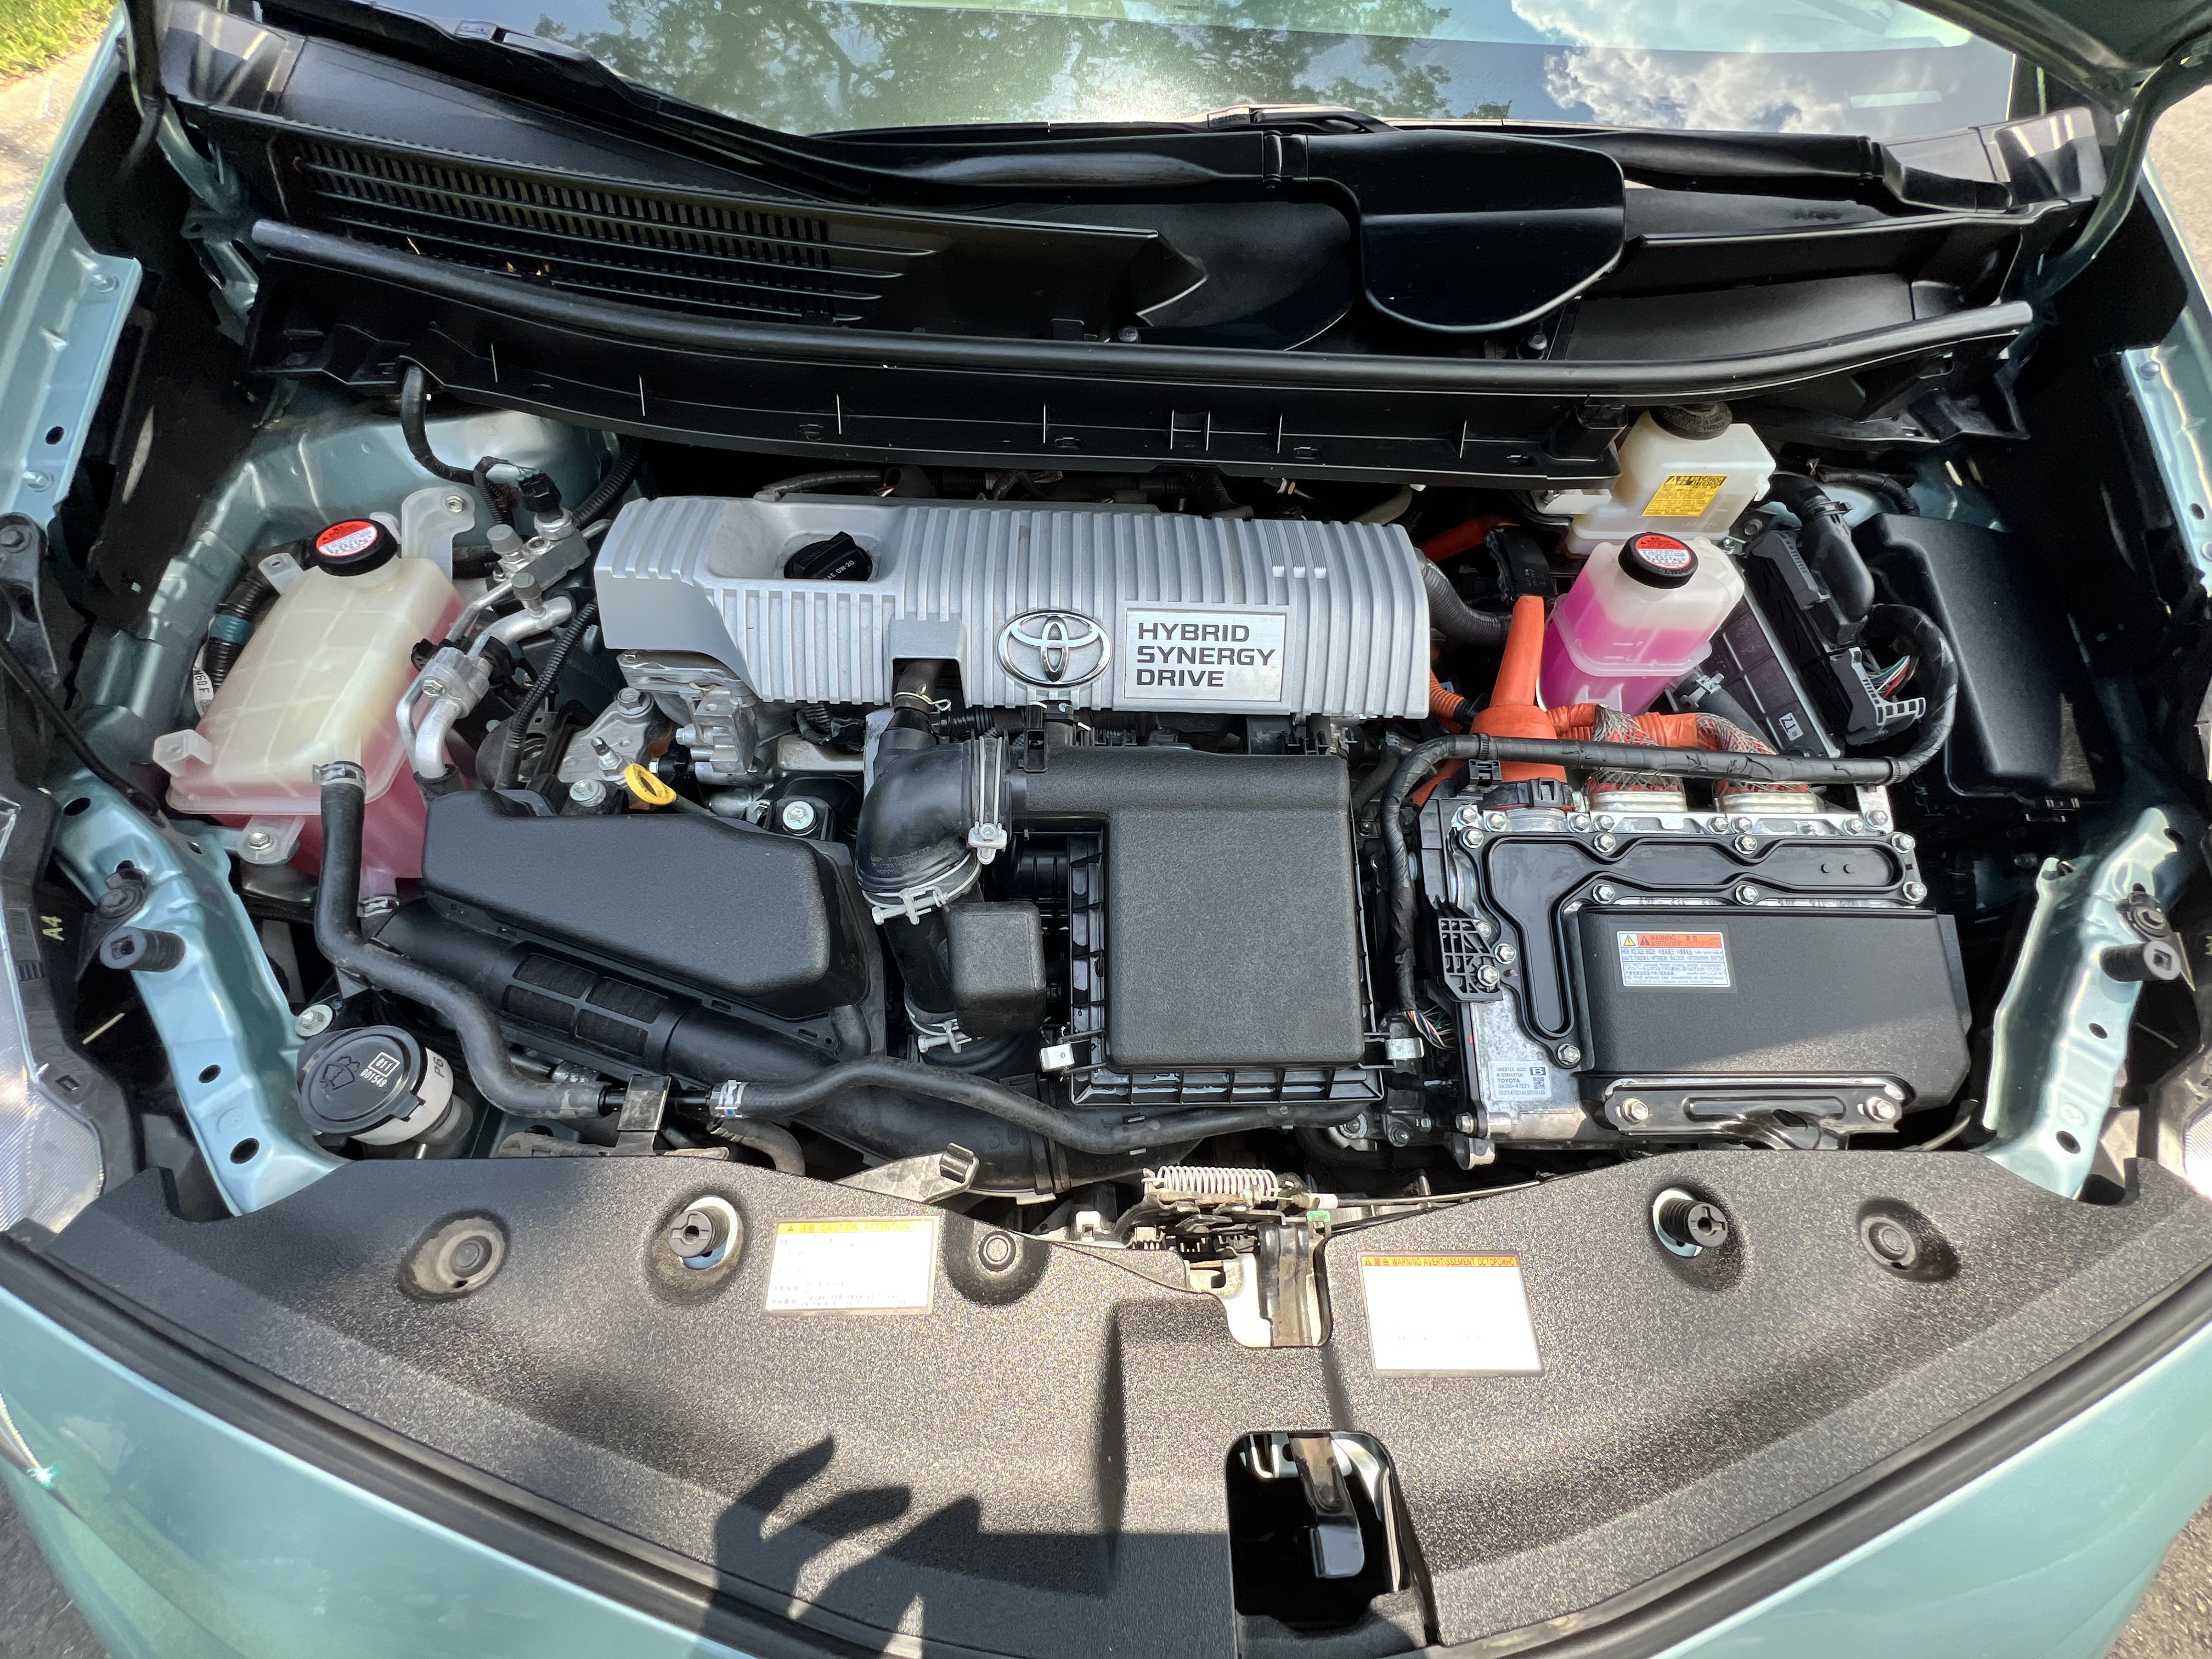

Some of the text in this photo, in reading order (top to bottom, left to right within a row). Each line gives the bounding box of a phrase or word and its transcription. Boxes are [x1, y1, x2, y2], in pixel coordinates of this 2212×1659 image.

[836, 560, 855, 574] 0W-20
[1138, 623, 1249, 642] HYBRID
[1137, 646, 1276, 666] SYNERGY
[1136, 669, 1224, 687] DRIVE
[1781, 715, 1796, 732] Z1
[40, 916, 65, 941] A4
[375, 1058, 393, 1072] e11
[432, 1056, 445, 1078] P6
[360, 1068, 388, 1088] 001549
[821, 1223, 859, 1232] CAUTION
[864, 1223, 910, 1231] ATTENTION
